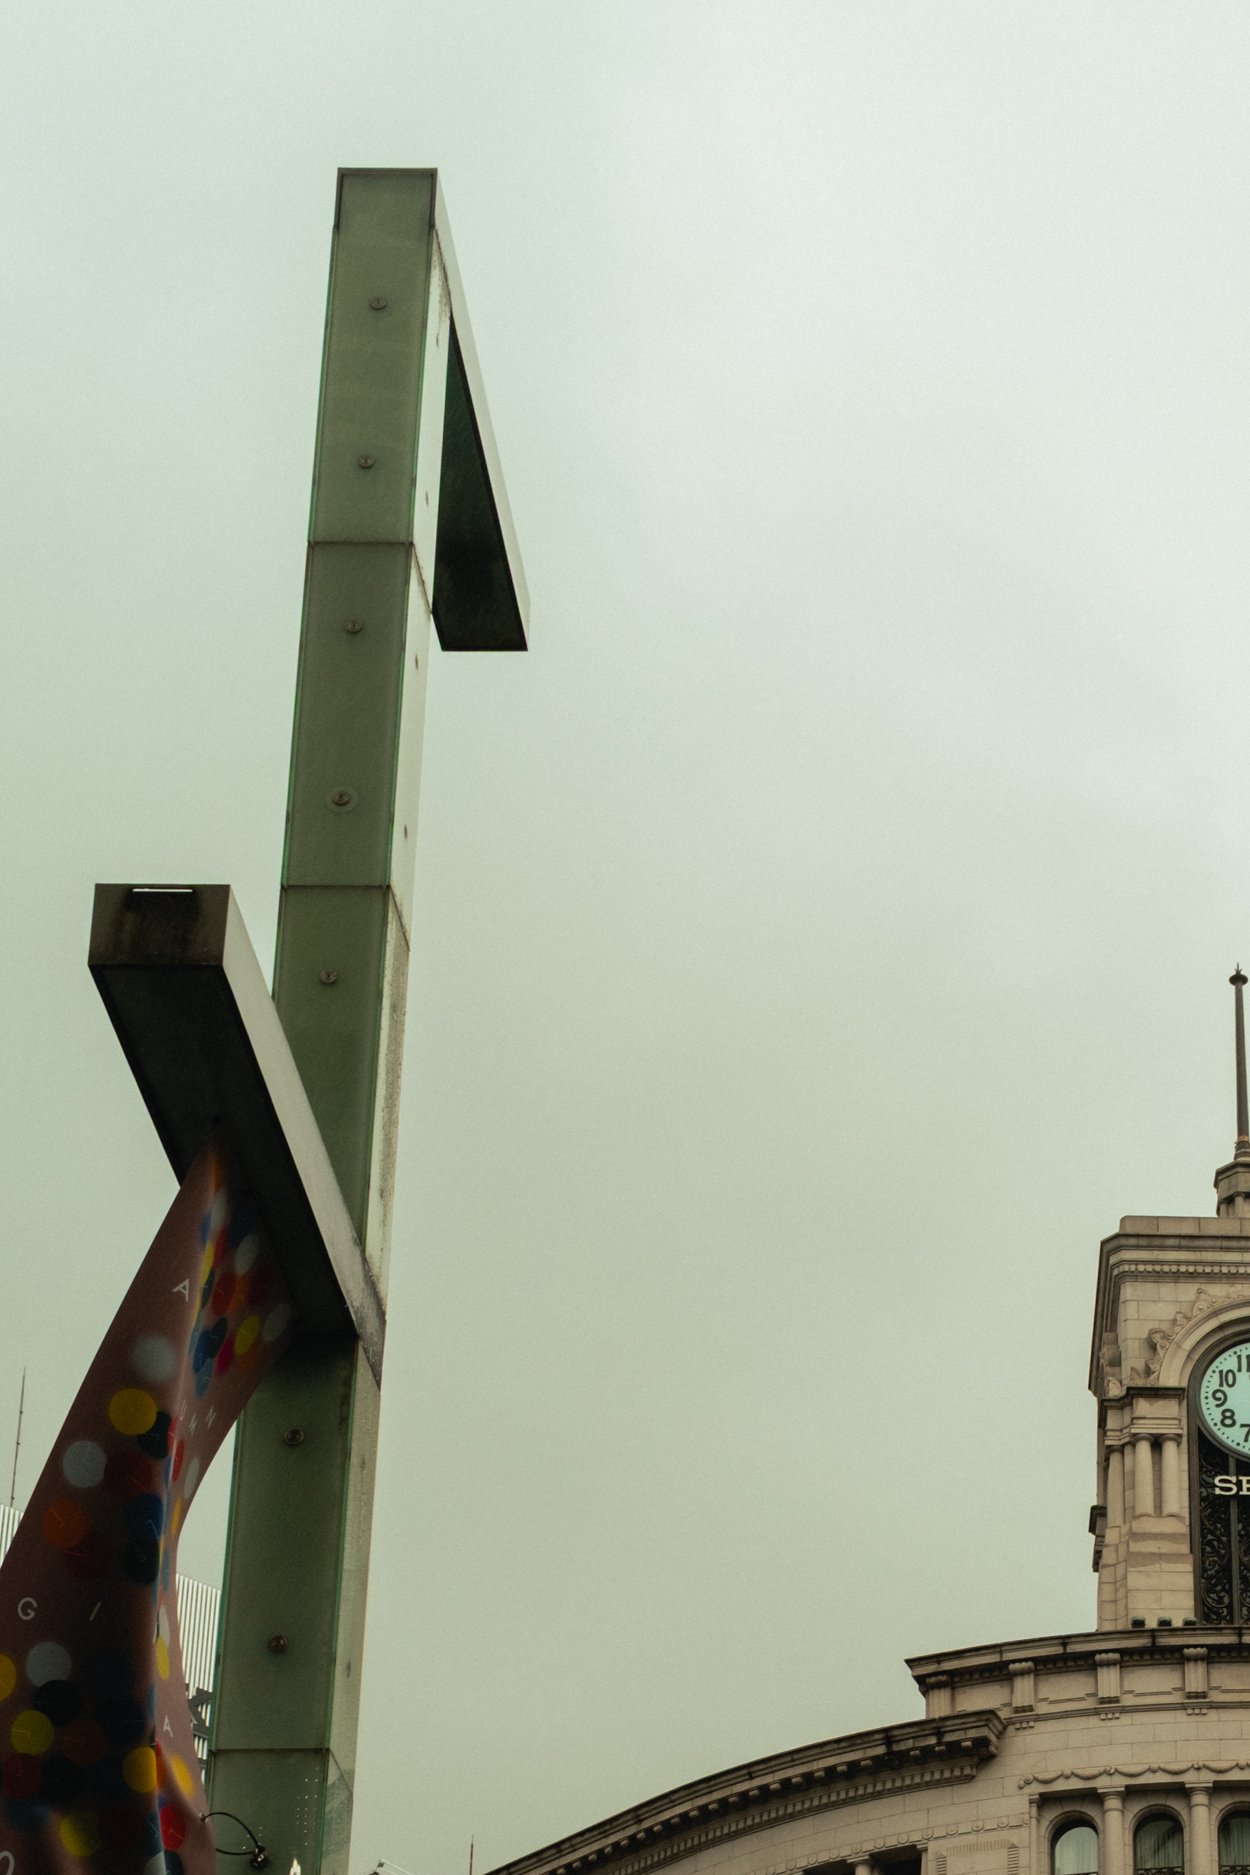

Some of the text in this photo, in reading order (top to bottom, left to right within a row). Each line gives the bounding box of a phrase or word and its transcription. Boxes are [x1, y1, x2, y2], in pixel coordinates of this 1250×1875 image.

[1218, 1369, 1237, 1388] 10
[1212, 1388, 1228, 1408] 9
[1220, 1408, 1237, 1428] 8
